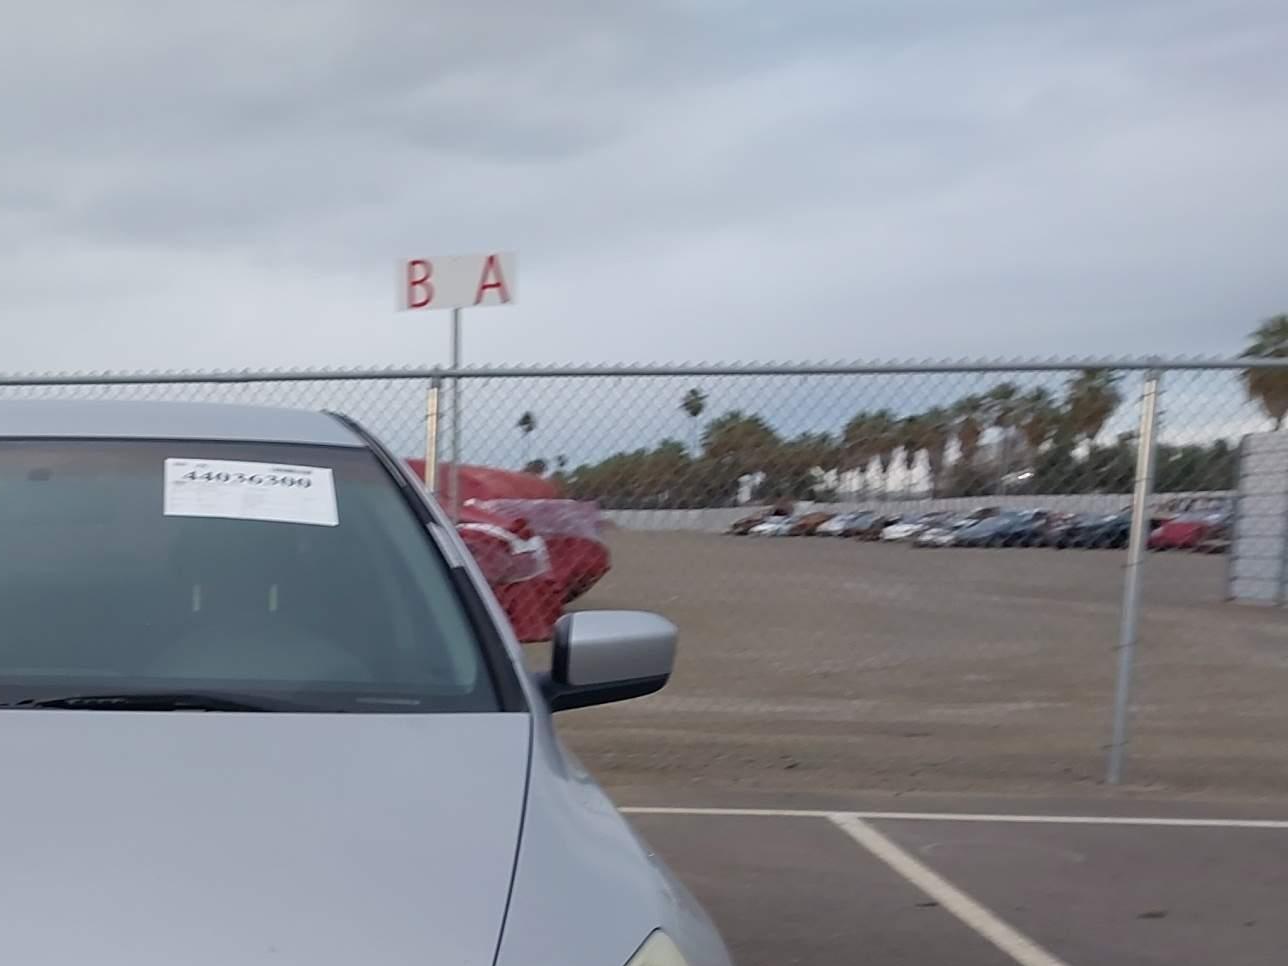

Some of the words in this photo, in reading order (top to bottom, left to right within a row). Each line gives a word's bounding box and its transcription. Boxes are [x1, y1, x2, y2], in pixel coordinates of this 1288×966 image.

[407, 260, 435, 308] B
[473, 254, 510, 305] A
[183, 470, 312, 489] 44036300
